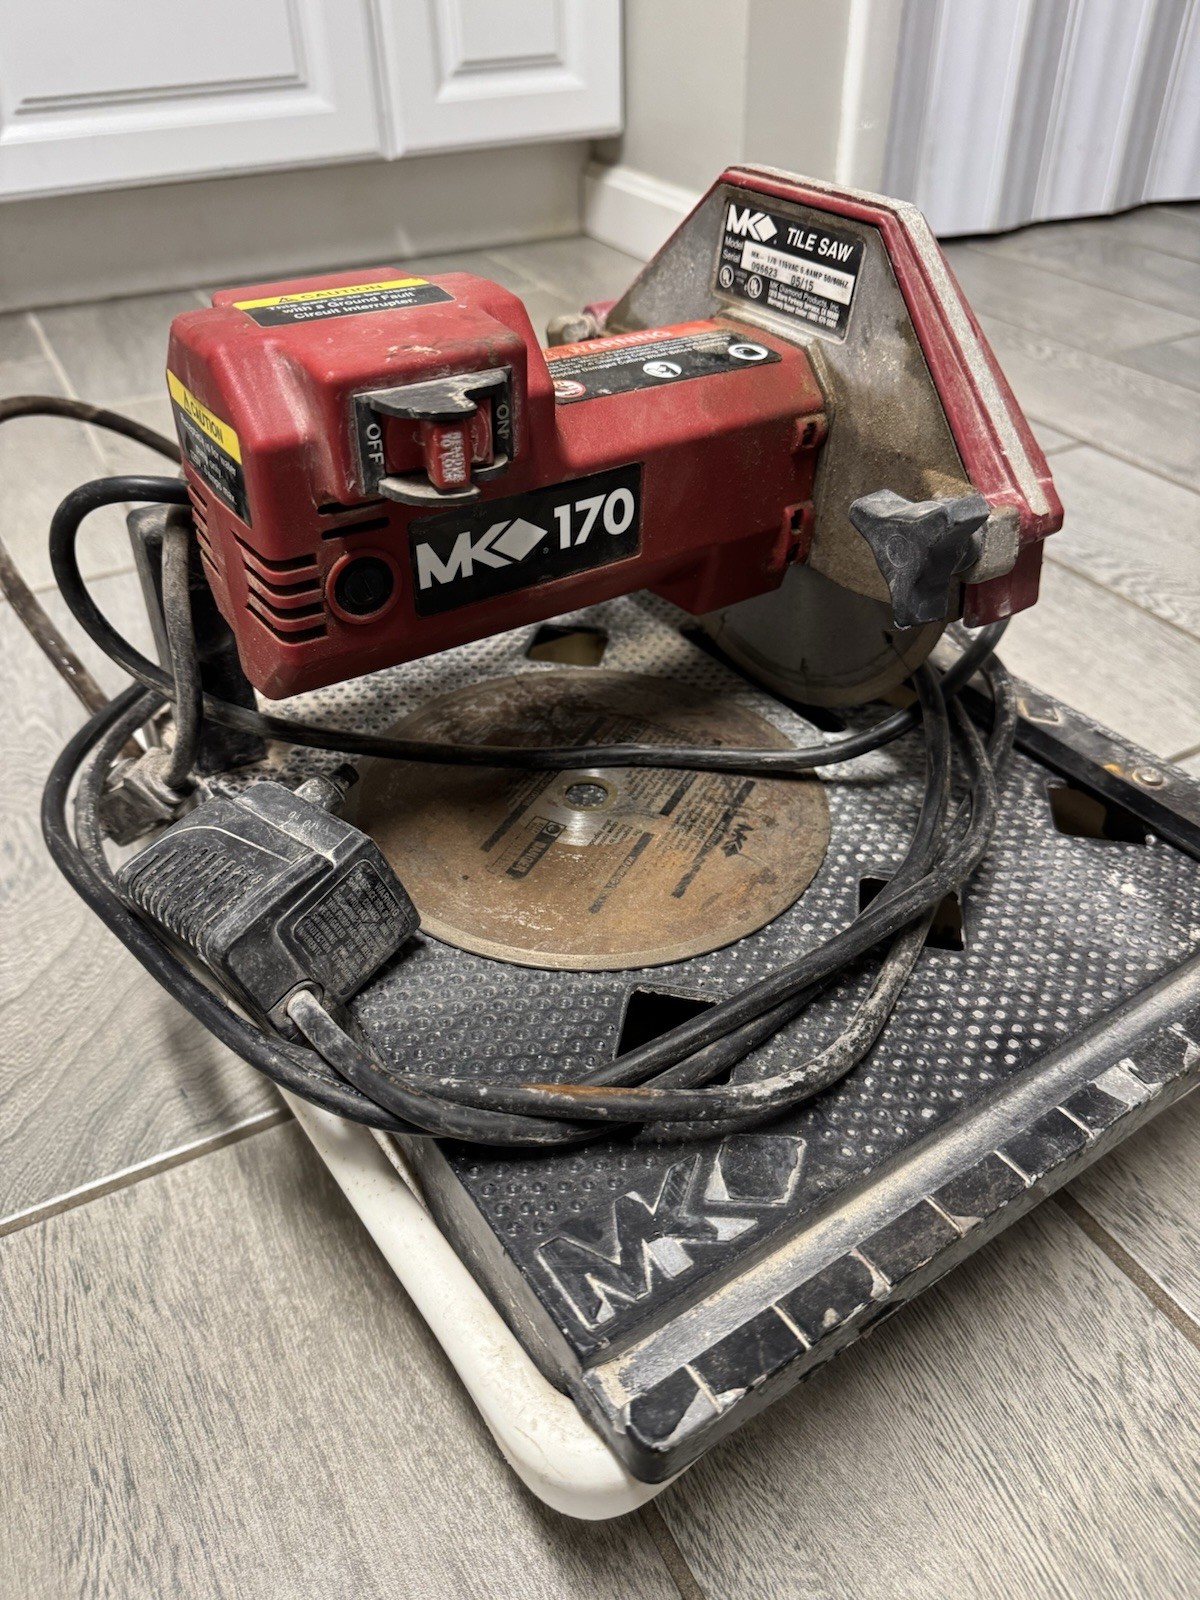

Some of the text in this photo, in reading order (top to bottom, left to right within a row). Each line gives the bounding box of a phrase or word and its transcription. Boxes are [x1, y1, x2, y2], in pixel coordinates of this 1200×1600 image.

[725, 236, 743, 249] Model
[727, 204, 853, 262] MK TILE SAW
[722, 249, 741, 263] Serial
[300, 283, 383, 299] CAUTION
[779, 284, 803, 299] Diamond
[790, 275, 813, 291] 05/15
[282, 304, 312, 314] with
[327, 295, 379, 308] Ground
[380, 290, 414, 300] Fault
[293, 298, 418, 320] Circuit Interrupter.
[568, 331, 672, 352] WARNING
[189, 398, 224, 445] CAUTION
[496, 403, 510, 436] ON
[366, 423, 385, 465] OFF
[416, 487, 635, 590] MK 170
[324, 896, 340, 914] THIS
[333, 909, 351, 929] PUMP
[337, 883, 347, 892] A
[344, 892, 371, 923] PROPERLY
[344, 875, 364, 898] SHOCK
[359, 897, 382, 922] CONNECT
[371, 881, 402, 917] WARNING
[302, 918, 333, 954] PROTECTION
[309, 911, 339, 945] SWIMMING
